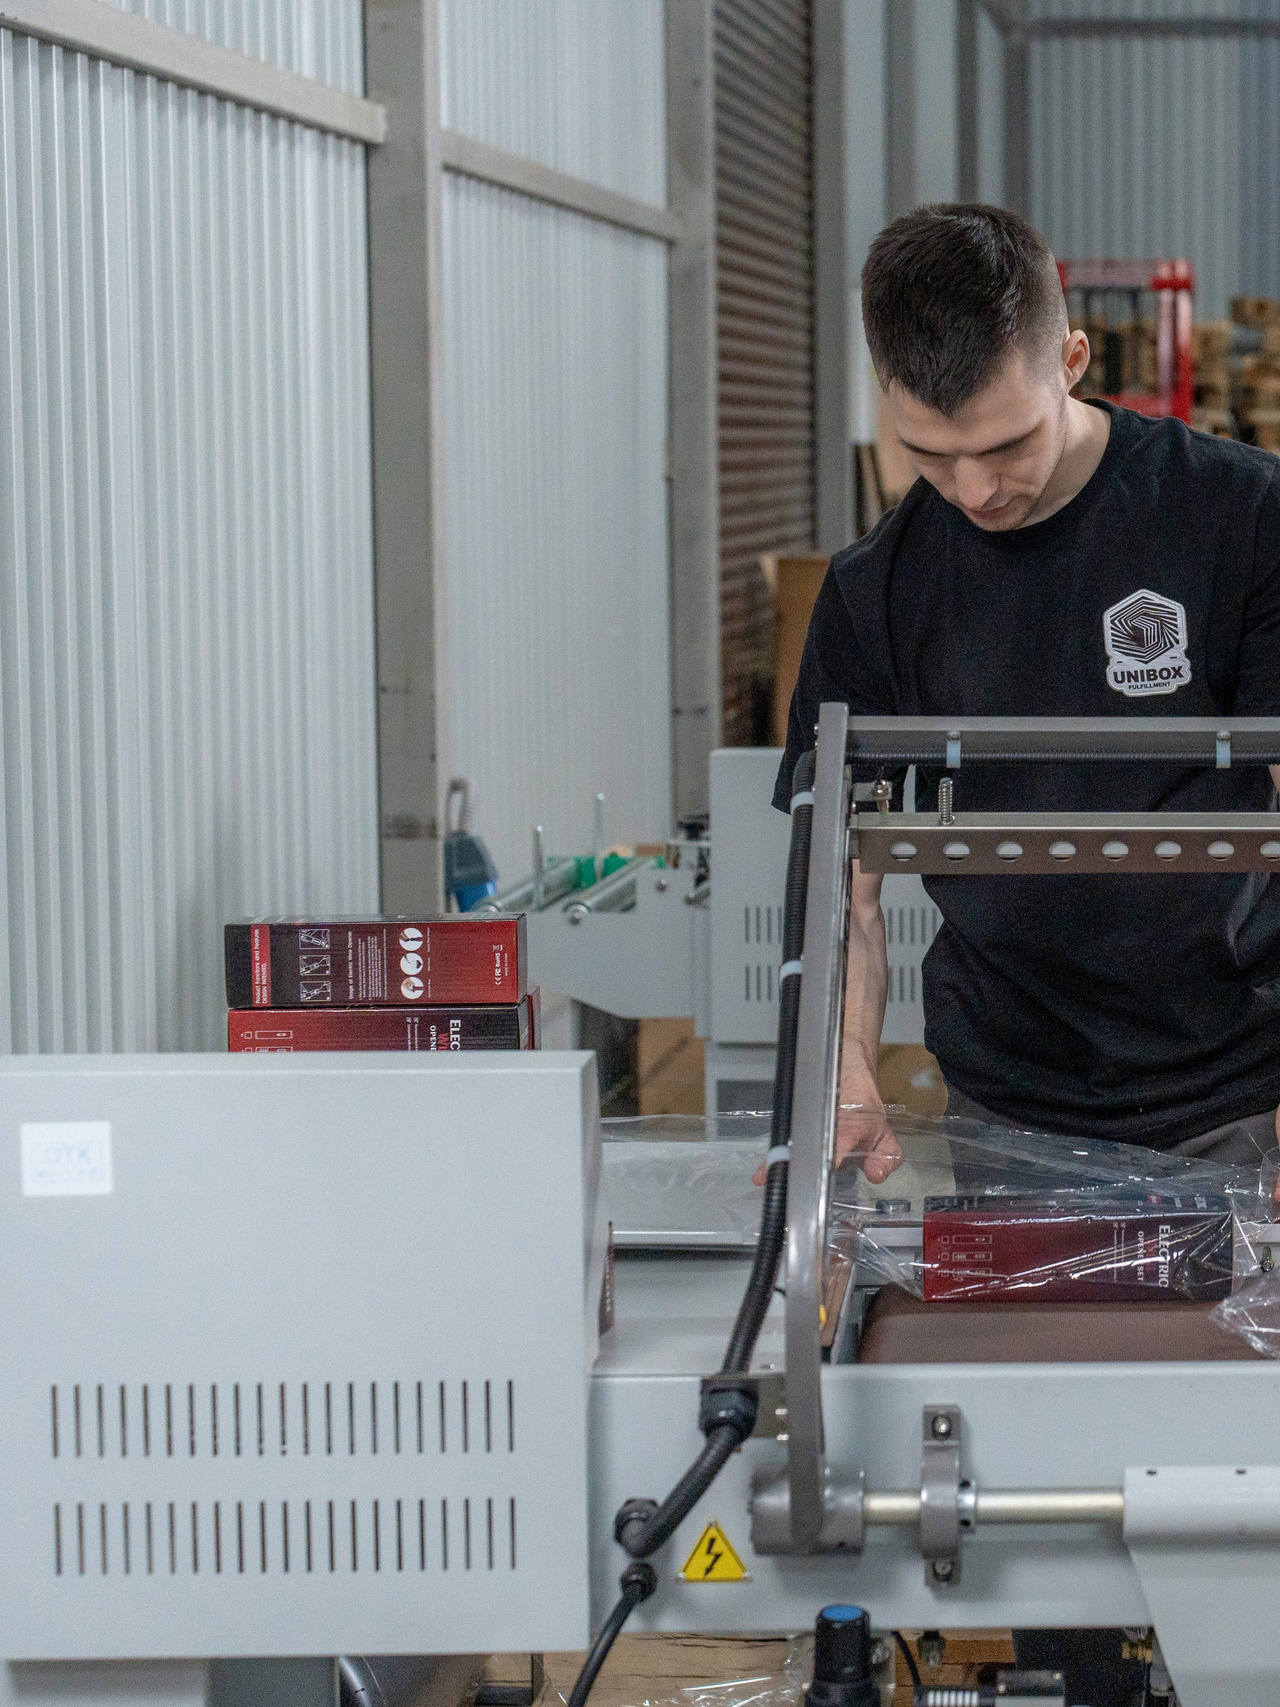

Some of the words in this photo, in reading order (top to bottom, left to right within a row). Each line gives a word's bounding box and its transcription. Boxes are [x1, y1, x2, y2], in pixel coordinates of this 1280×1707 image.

[1113, 665, 1184, 684] UNIBOX
[1128, 681, 1171, 690] FULFILLMENT
[450, 1019, 461, 1051] ELEC
